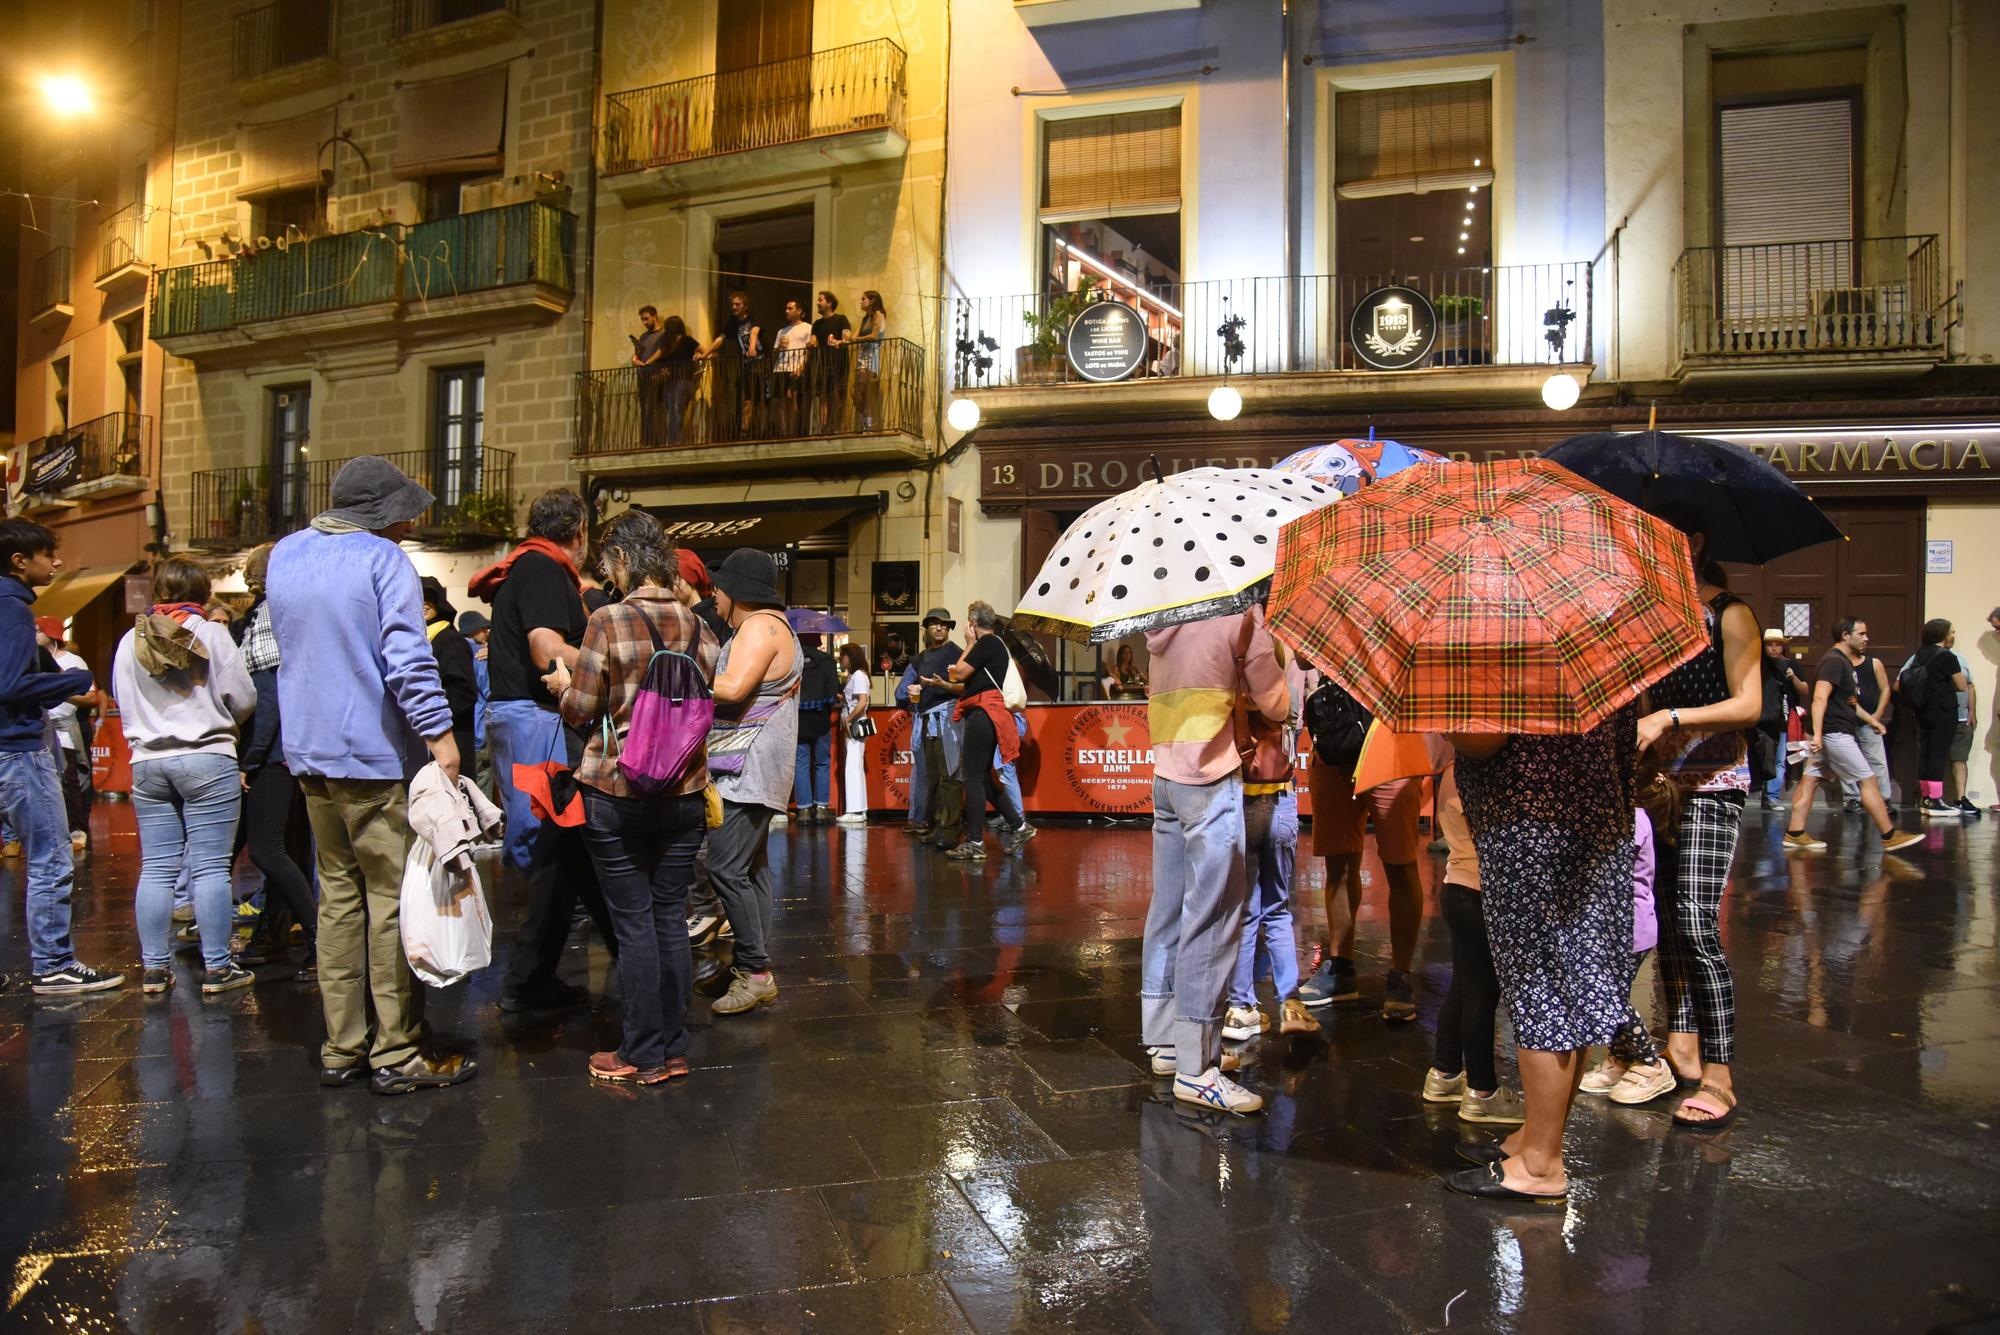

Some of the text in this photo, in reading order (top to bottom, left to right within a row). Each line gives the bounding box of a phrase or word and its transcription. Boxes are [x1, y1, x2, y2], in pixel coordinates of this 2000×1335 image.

[1379, 314, 1408, 326] 1913
[991, 464, 1016, 485] 13
[664, 517, 762, 535] 1913
[1068, 708, 1100, 743] CERVESA
[1078, 749, 1155, 764] ESTRELLA
[1103, 764, 1132, 773] DAMM
[1066, 768, 1090, 801] AUGUST
